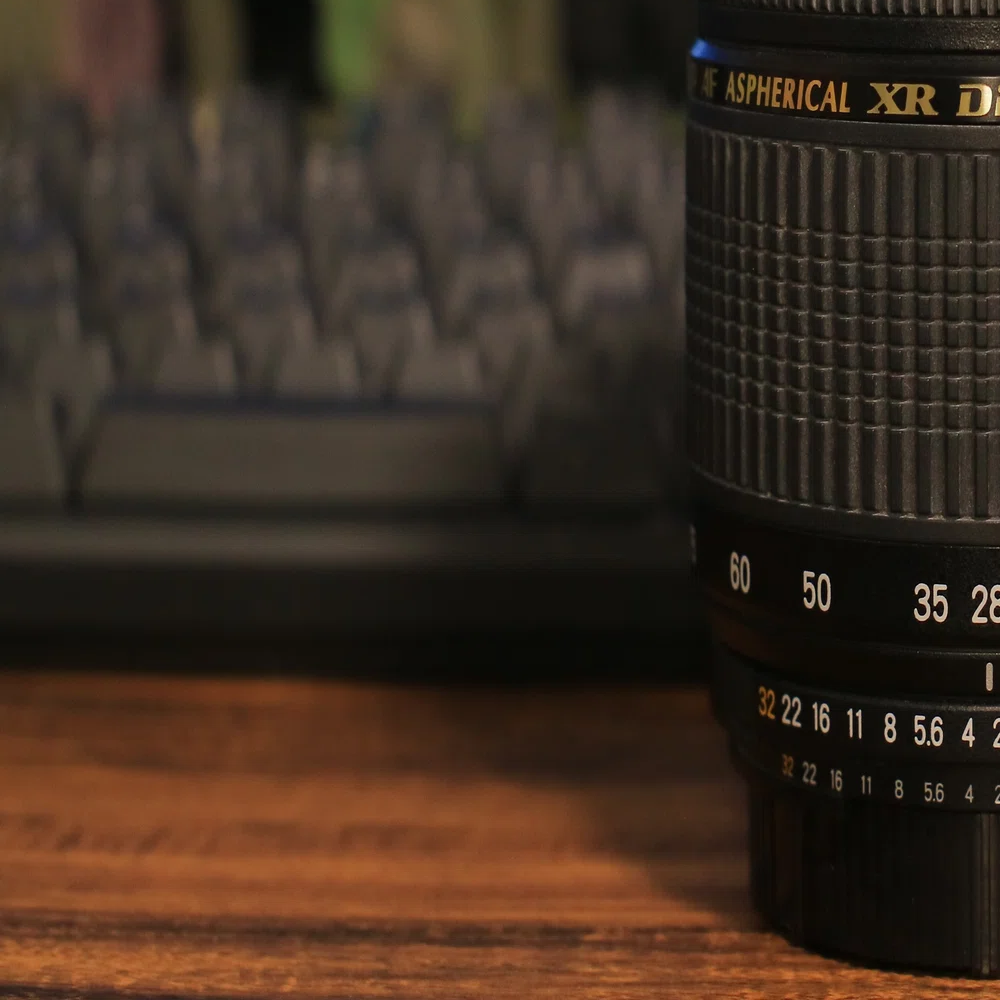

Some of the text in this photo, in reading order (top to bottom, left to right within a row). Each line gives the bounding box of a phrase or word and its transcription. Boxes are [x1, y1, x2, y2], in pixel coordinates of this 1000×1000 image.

[725, 71, 851, 113] ASPHERICAL
[866, 82, 939, 116] XR
[730, 551, 750, 594] 60
[803, 571, 832, 611] 50
[913, 583, 949, 622] 35
[758, 686, 776, 719] 32
[781, 694, 801, 728] 22
[812, 702, 830, 733] 16
[847, 708, 863, 739] 11
[884, 713, 897, 743] 8
[914, 715, 944, 746] 5.6
[961, 718, 976, 747] 4
[782, 753, 794, 777] 32
[802, 761, 817, 785] 22
[830, 769, 843, 792] 16
[861, 775, 872, 795] 11
[894, 780, 904, 799] 8
[924, 782, 945, 803] 5.6
[965, 784, 974, 803] 4
